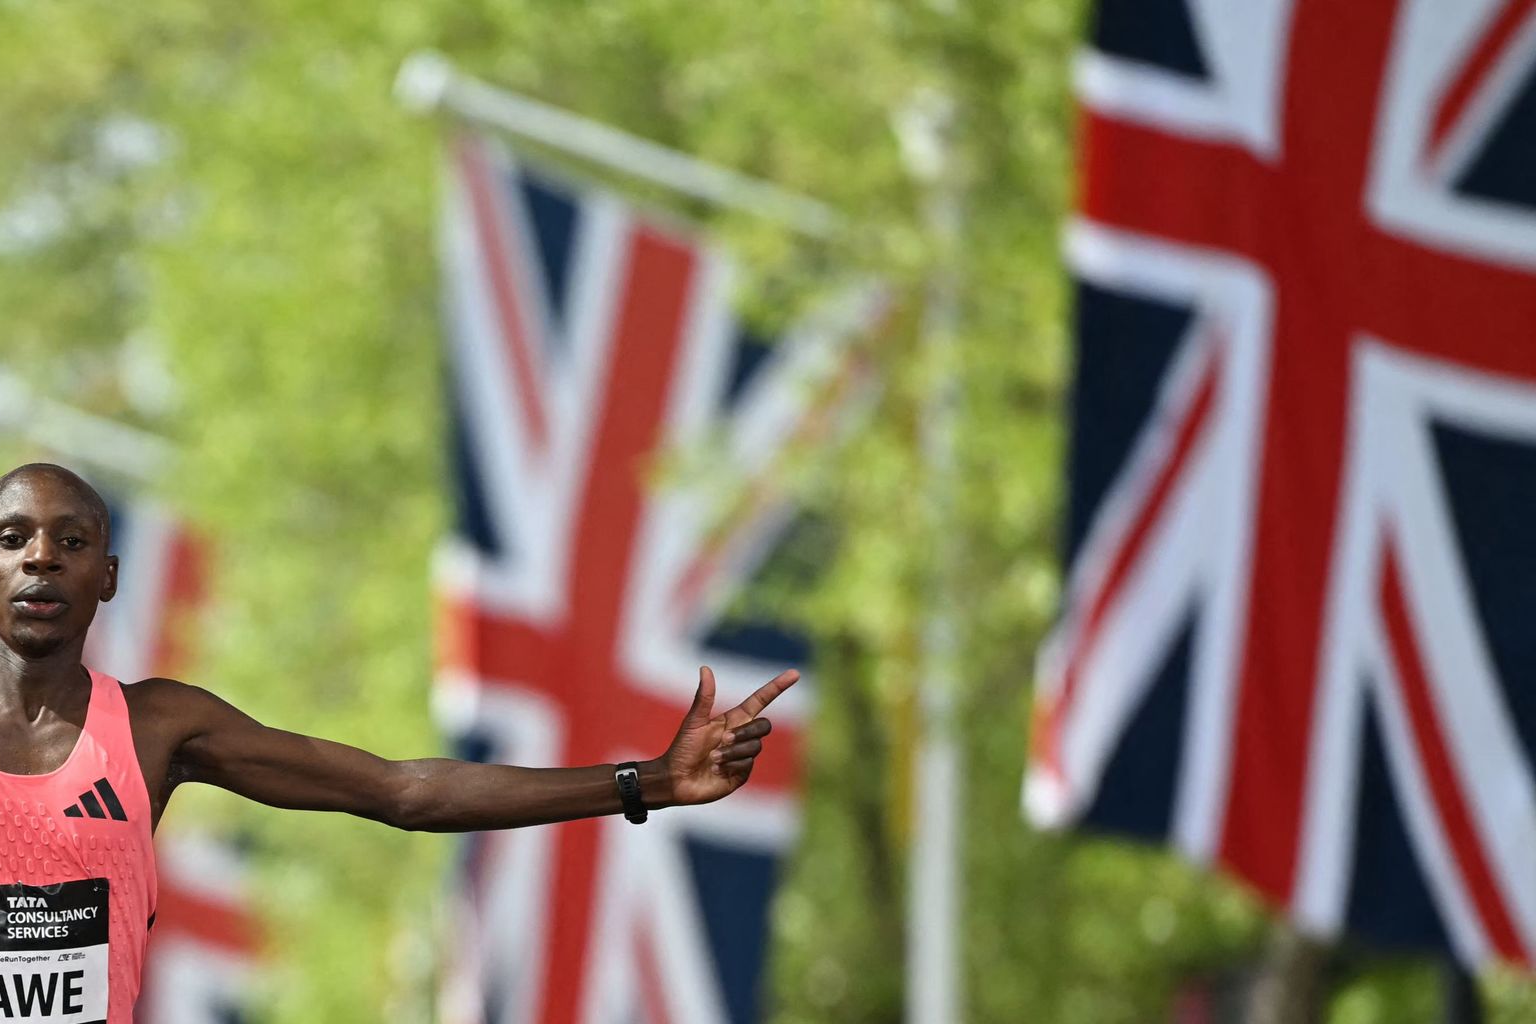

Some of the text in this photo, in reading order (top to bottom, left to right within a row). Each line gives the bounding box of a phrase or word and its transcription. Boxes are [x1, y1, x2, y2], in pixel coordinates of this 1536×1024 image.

[6, 896, 48, 909] TATA
[6, 906, 98, 924] CONSULTANCY
[7, 925, 69, 939] SERVICES
